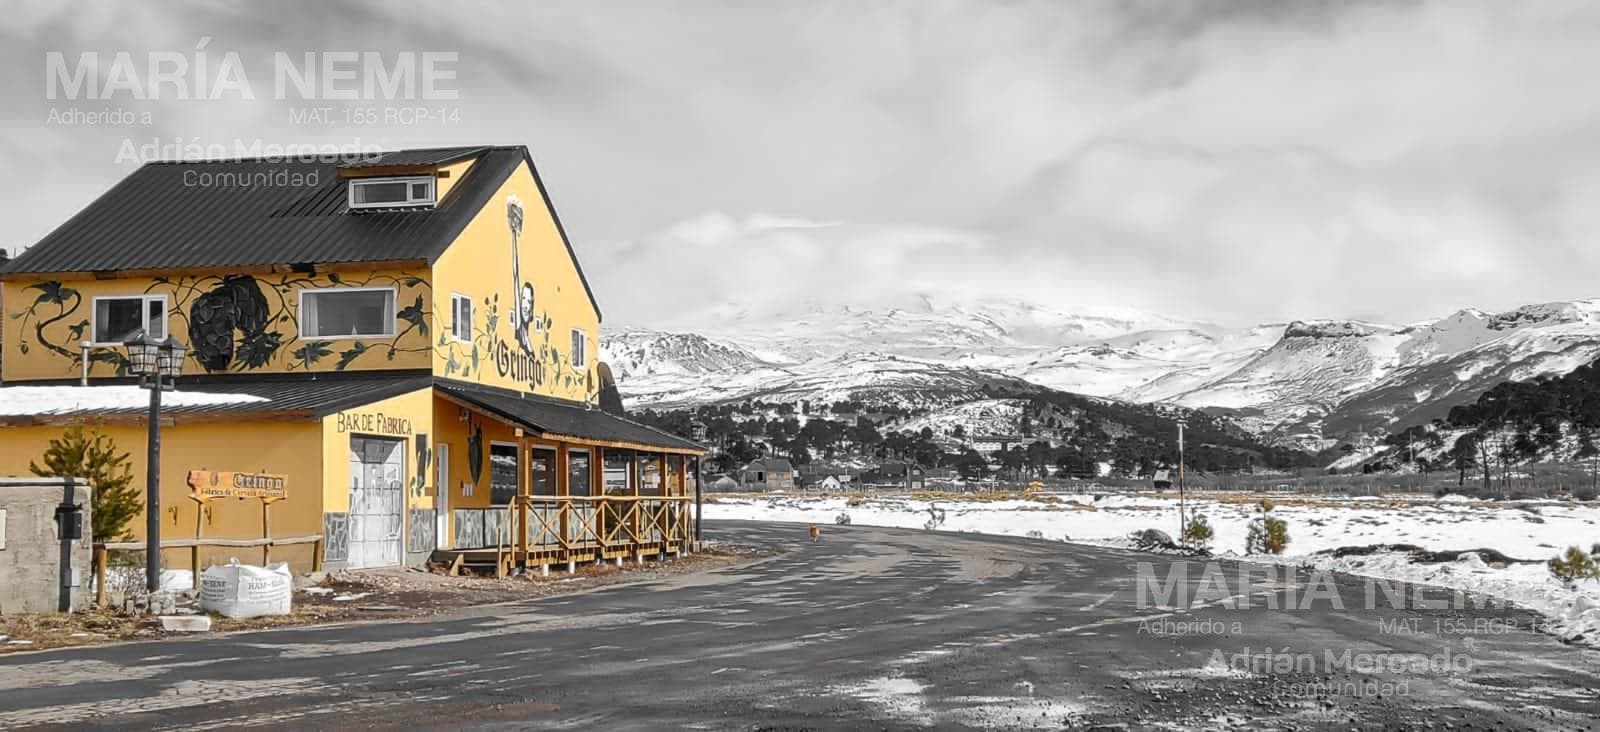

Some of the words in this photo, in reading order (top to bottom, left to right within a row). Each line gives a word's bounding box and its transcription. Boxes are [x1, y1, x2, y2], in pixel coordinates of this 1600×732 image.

[337, 411, 360, 433] BAR
[361, 414, 374, 432] DE
[377, 412, 412, 435] FABRICA
